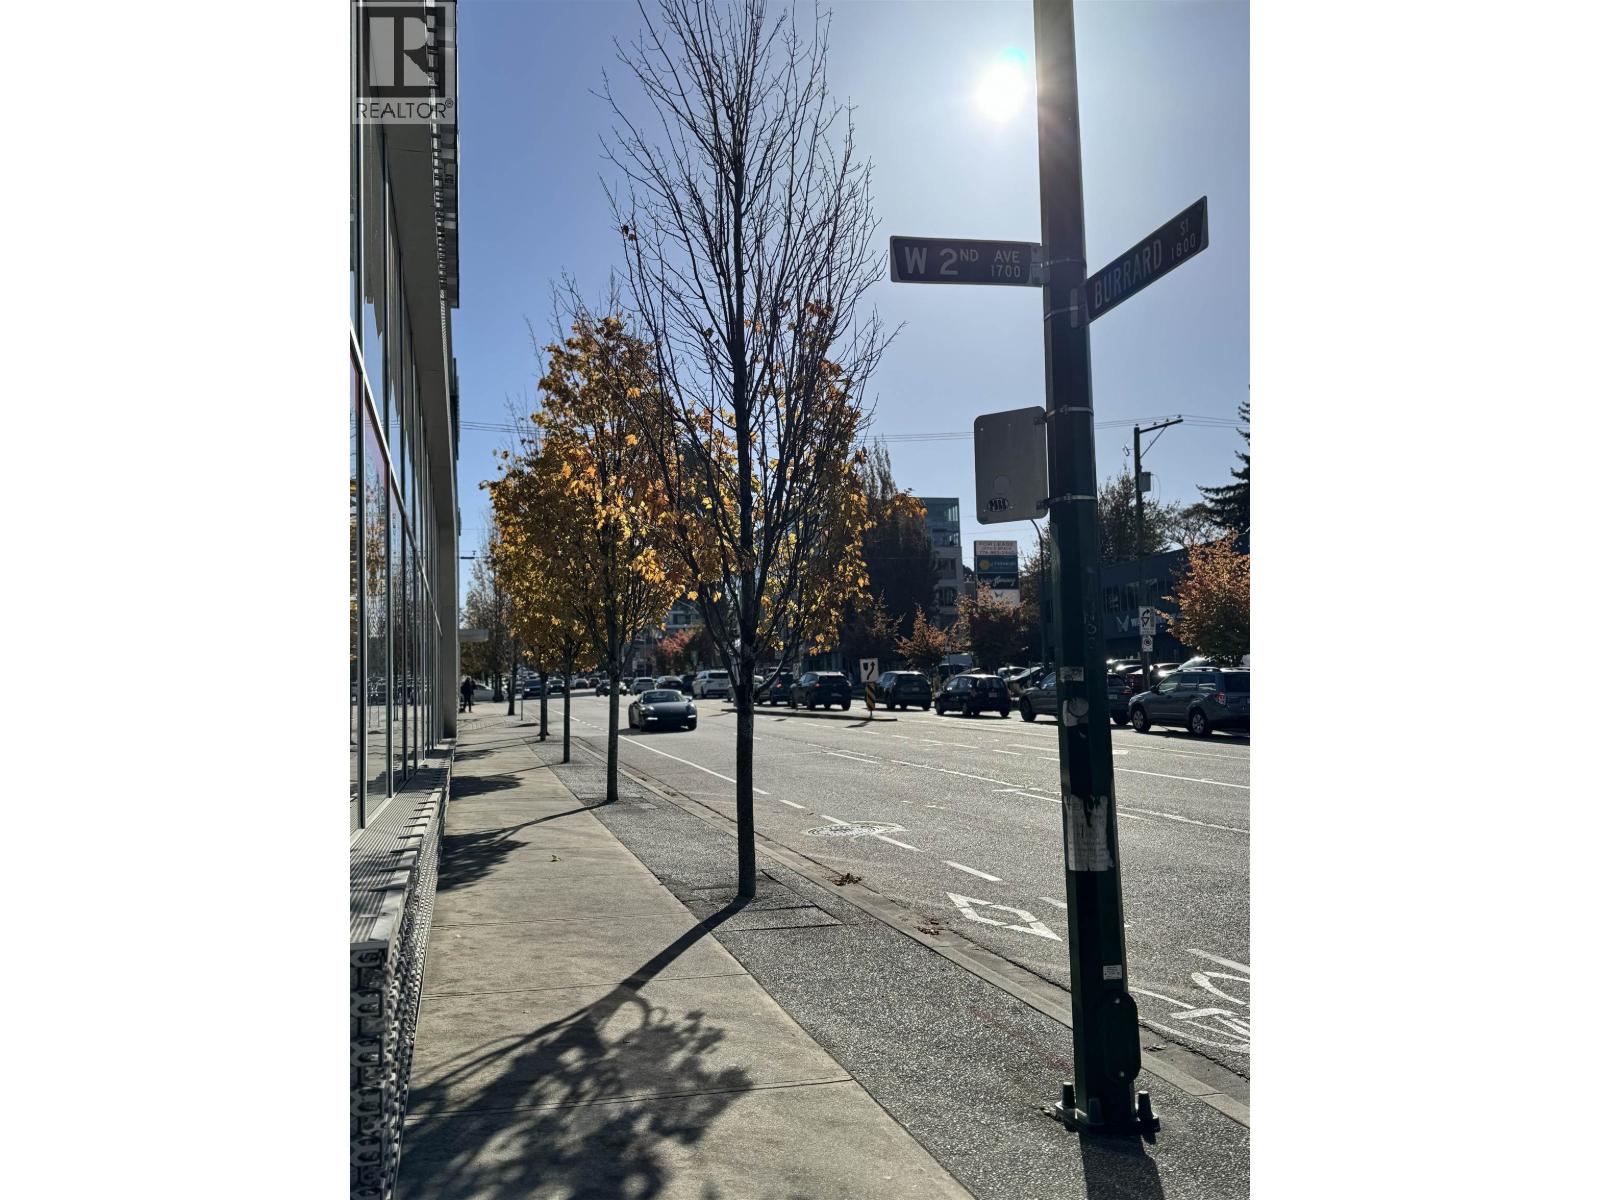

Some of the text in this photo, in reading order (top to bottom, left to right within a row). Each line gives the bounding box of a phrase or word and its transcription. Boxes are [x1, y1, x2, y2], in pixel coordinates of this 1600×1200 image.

[1171, 233, 1196, 260] 1800
[904, 246, 1021, 276] W 2ND AVE
[991, 264, 1021, 278] 1700
[1094, 218, 1189, 309] BURRARD ST
